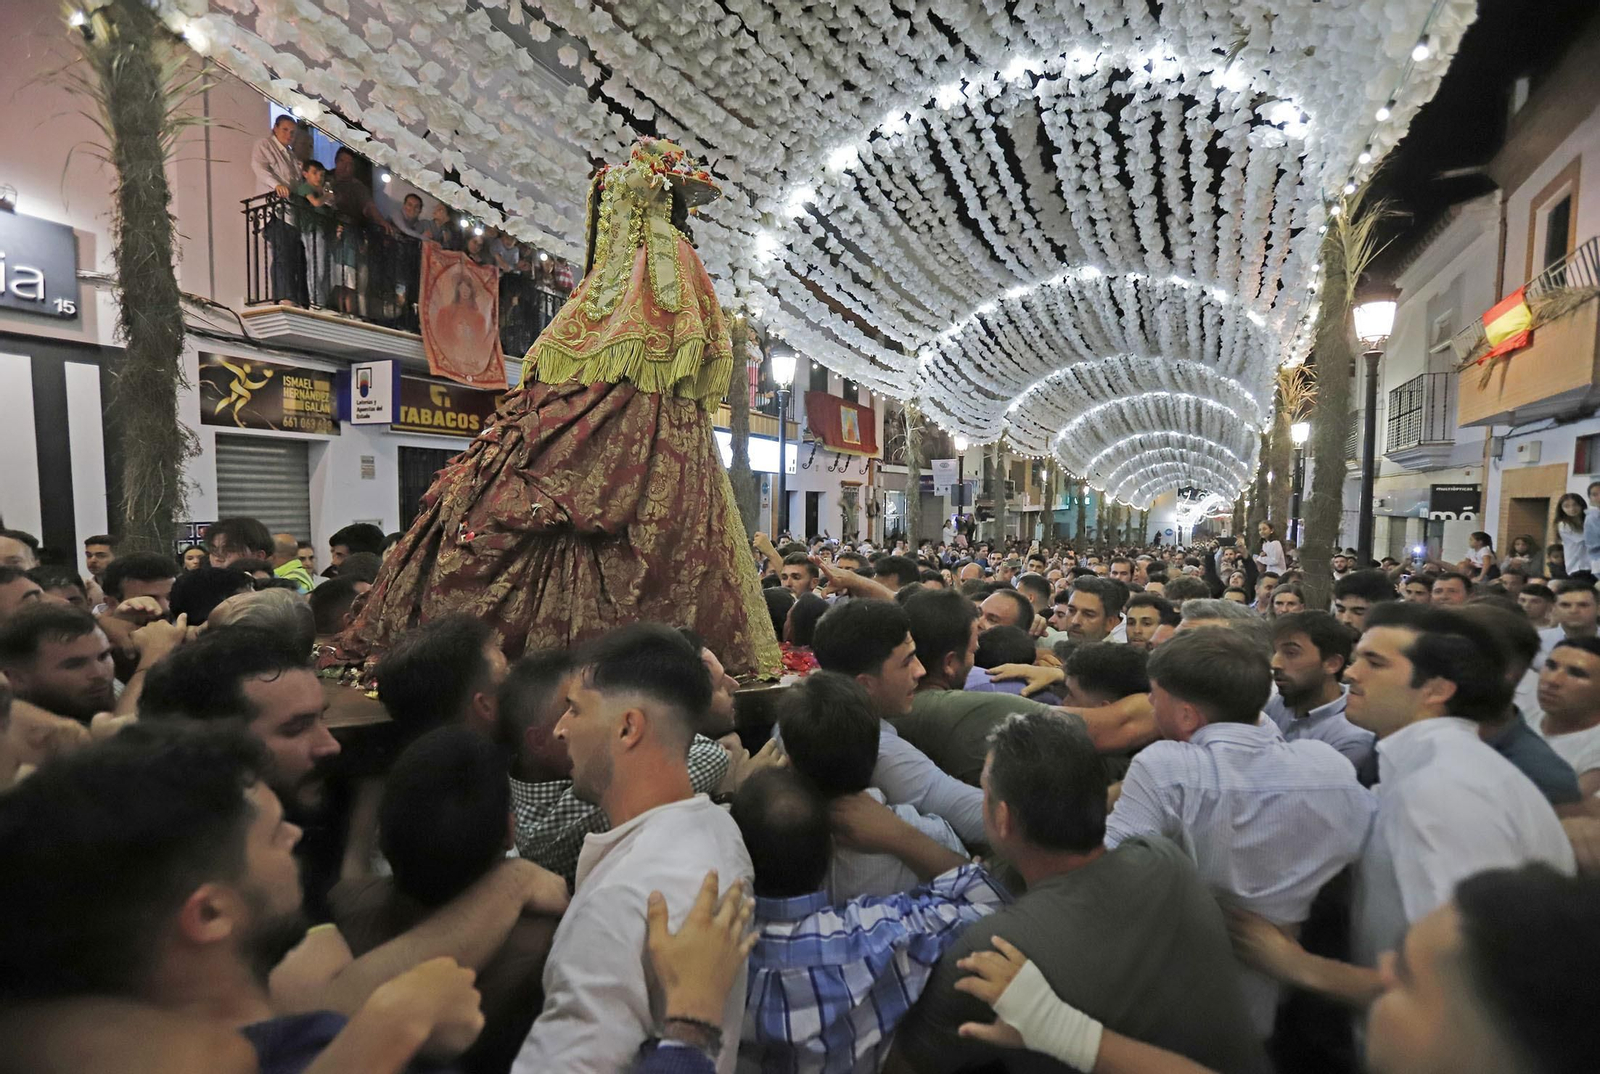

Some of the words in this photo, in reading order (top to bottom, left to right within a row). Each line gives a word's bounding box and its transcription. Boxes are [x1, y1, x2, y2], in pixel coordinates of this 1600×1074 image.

[53, 298, 76, 314] 15
[283, 375, 313, 390] ISMAEL
[400, 406, 479, 430] TABACOS
